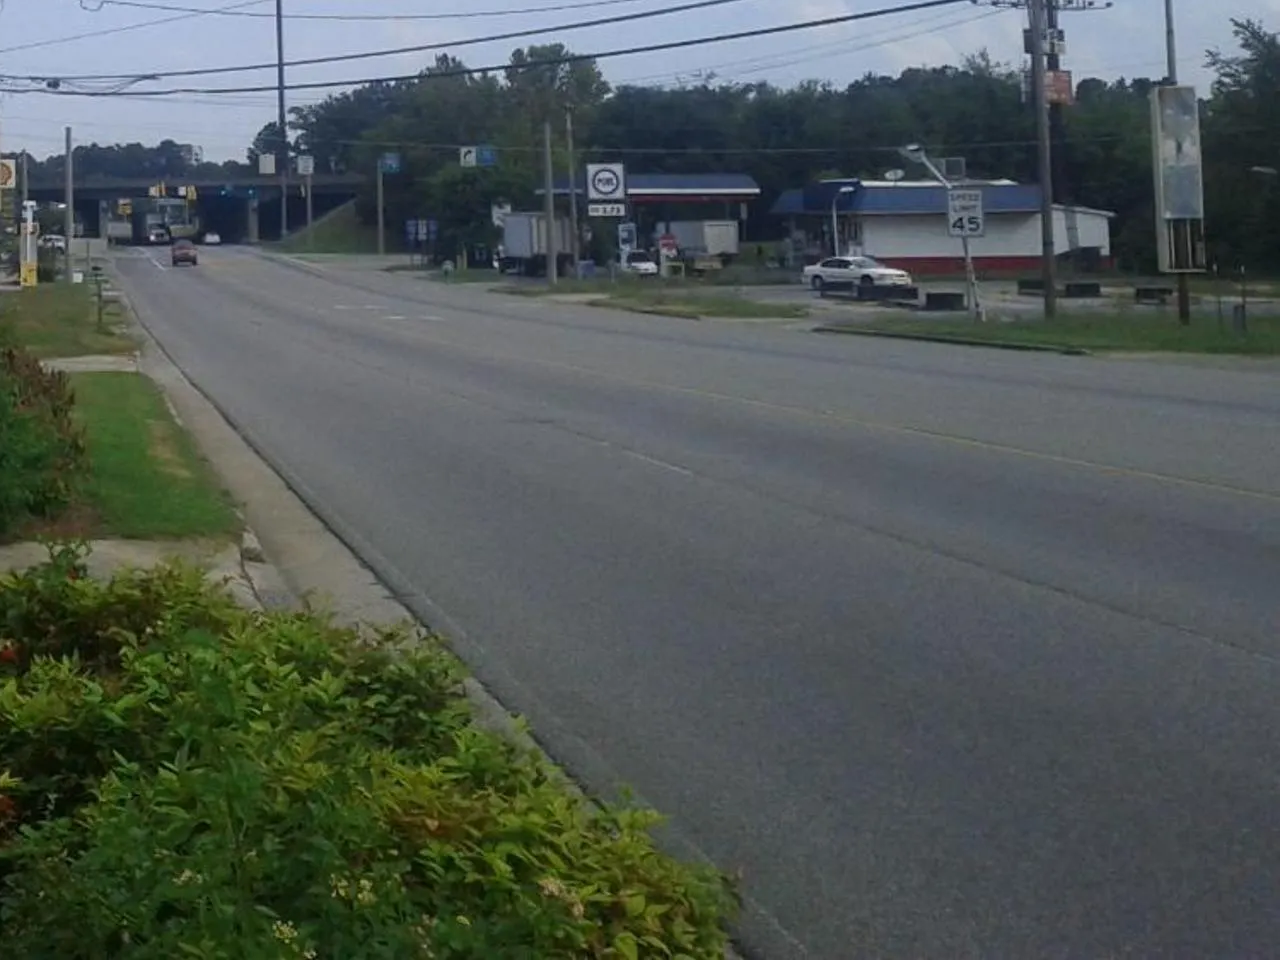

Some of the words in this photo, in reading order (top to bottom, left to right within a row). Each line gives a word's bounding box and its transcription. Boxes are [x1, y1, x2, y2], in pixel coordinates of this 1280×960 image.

[950, 193, 980, 201] SPEED
[952, 204, 978, 213] LIMIT
[952, 216, 980, 232] 45
